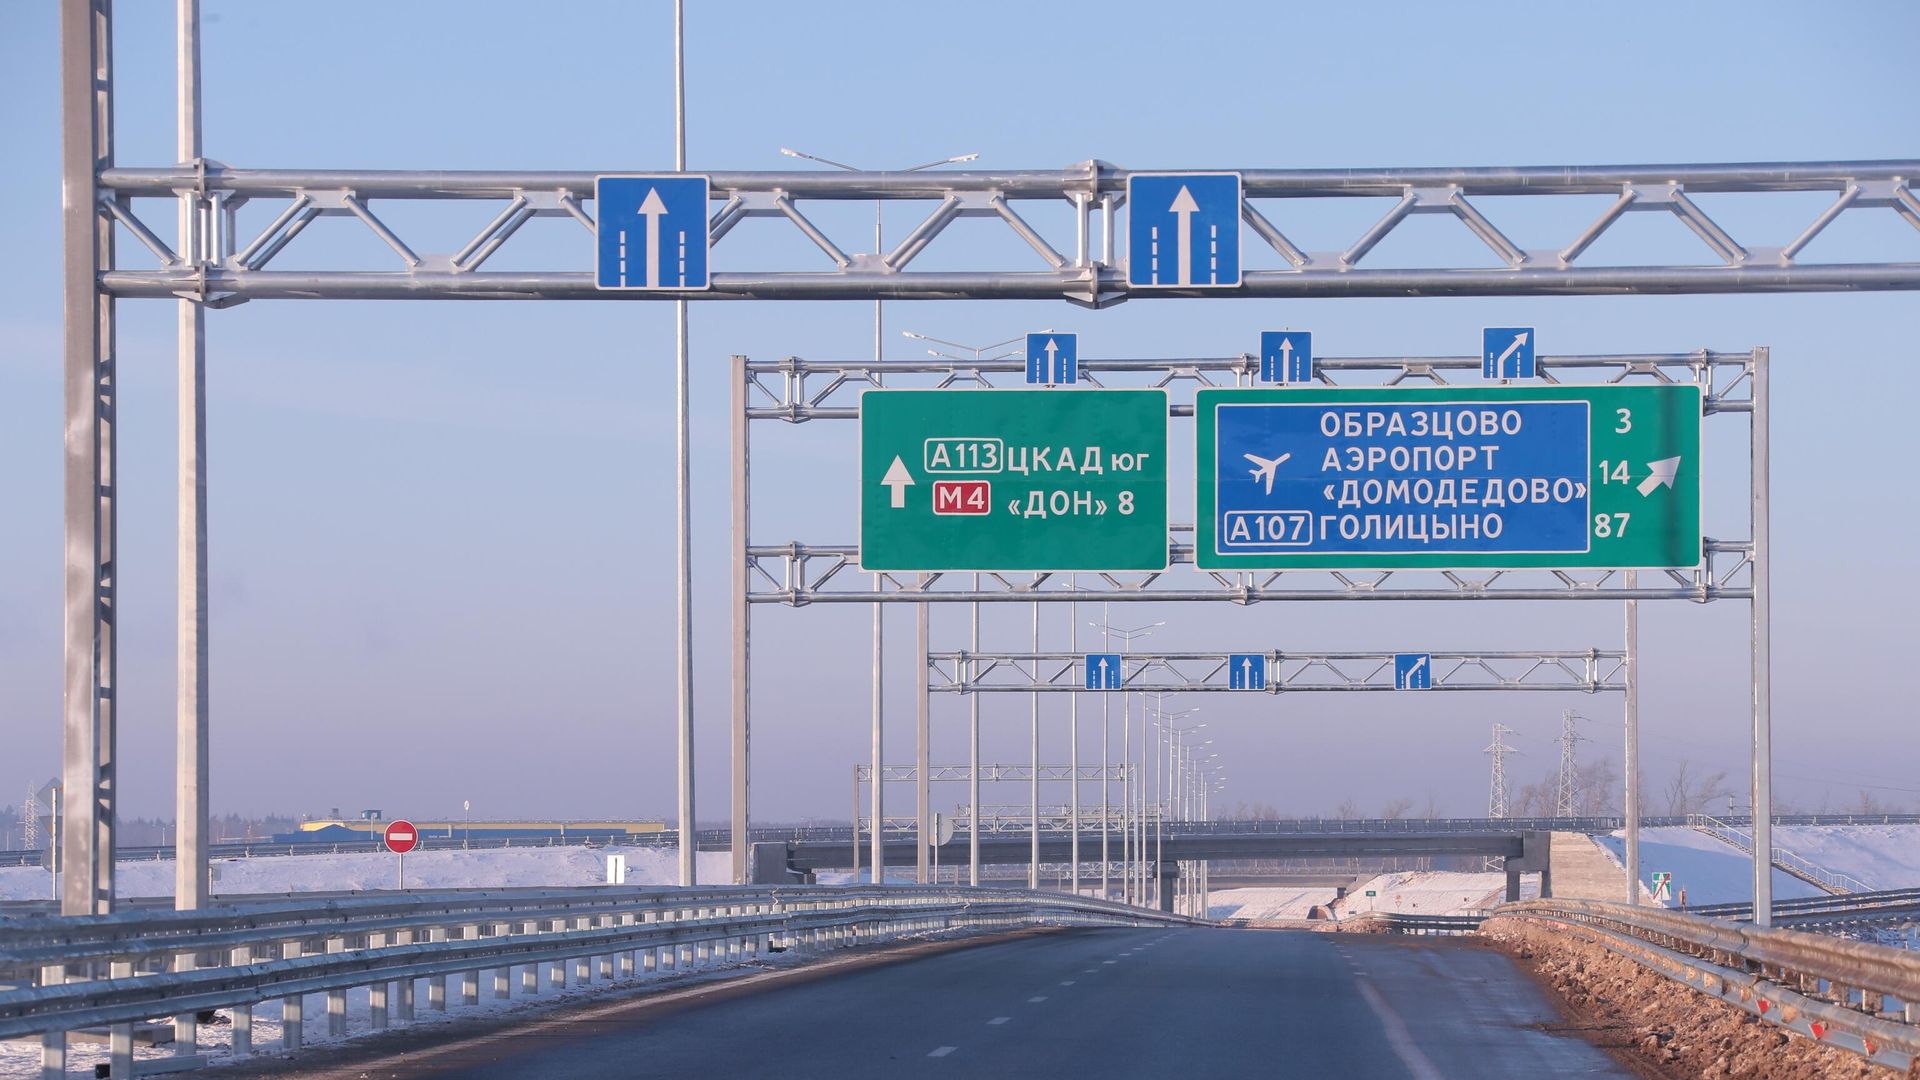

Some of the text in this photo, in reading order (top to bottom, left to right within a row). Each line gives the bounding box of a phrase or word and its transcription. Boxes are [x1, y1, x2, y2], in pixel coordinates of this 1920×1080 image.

[1321, 408, 1632, 440] ОБРАЗЦОВО 3
[930, 443, 1150, 476] А113 ЦКАД юг
[1322, 446, 1500, 472] АЭРОПОРТ
[1599, 460, 1631, 485] 14
[939, 487, 1135, 519] М4 «ДОН» 8
[1323, 478, 1587, 508] «ДОМОДЕДОВО»
[1230, 513, 1631, 544] А107 ГОЛИЦЫНО 87
